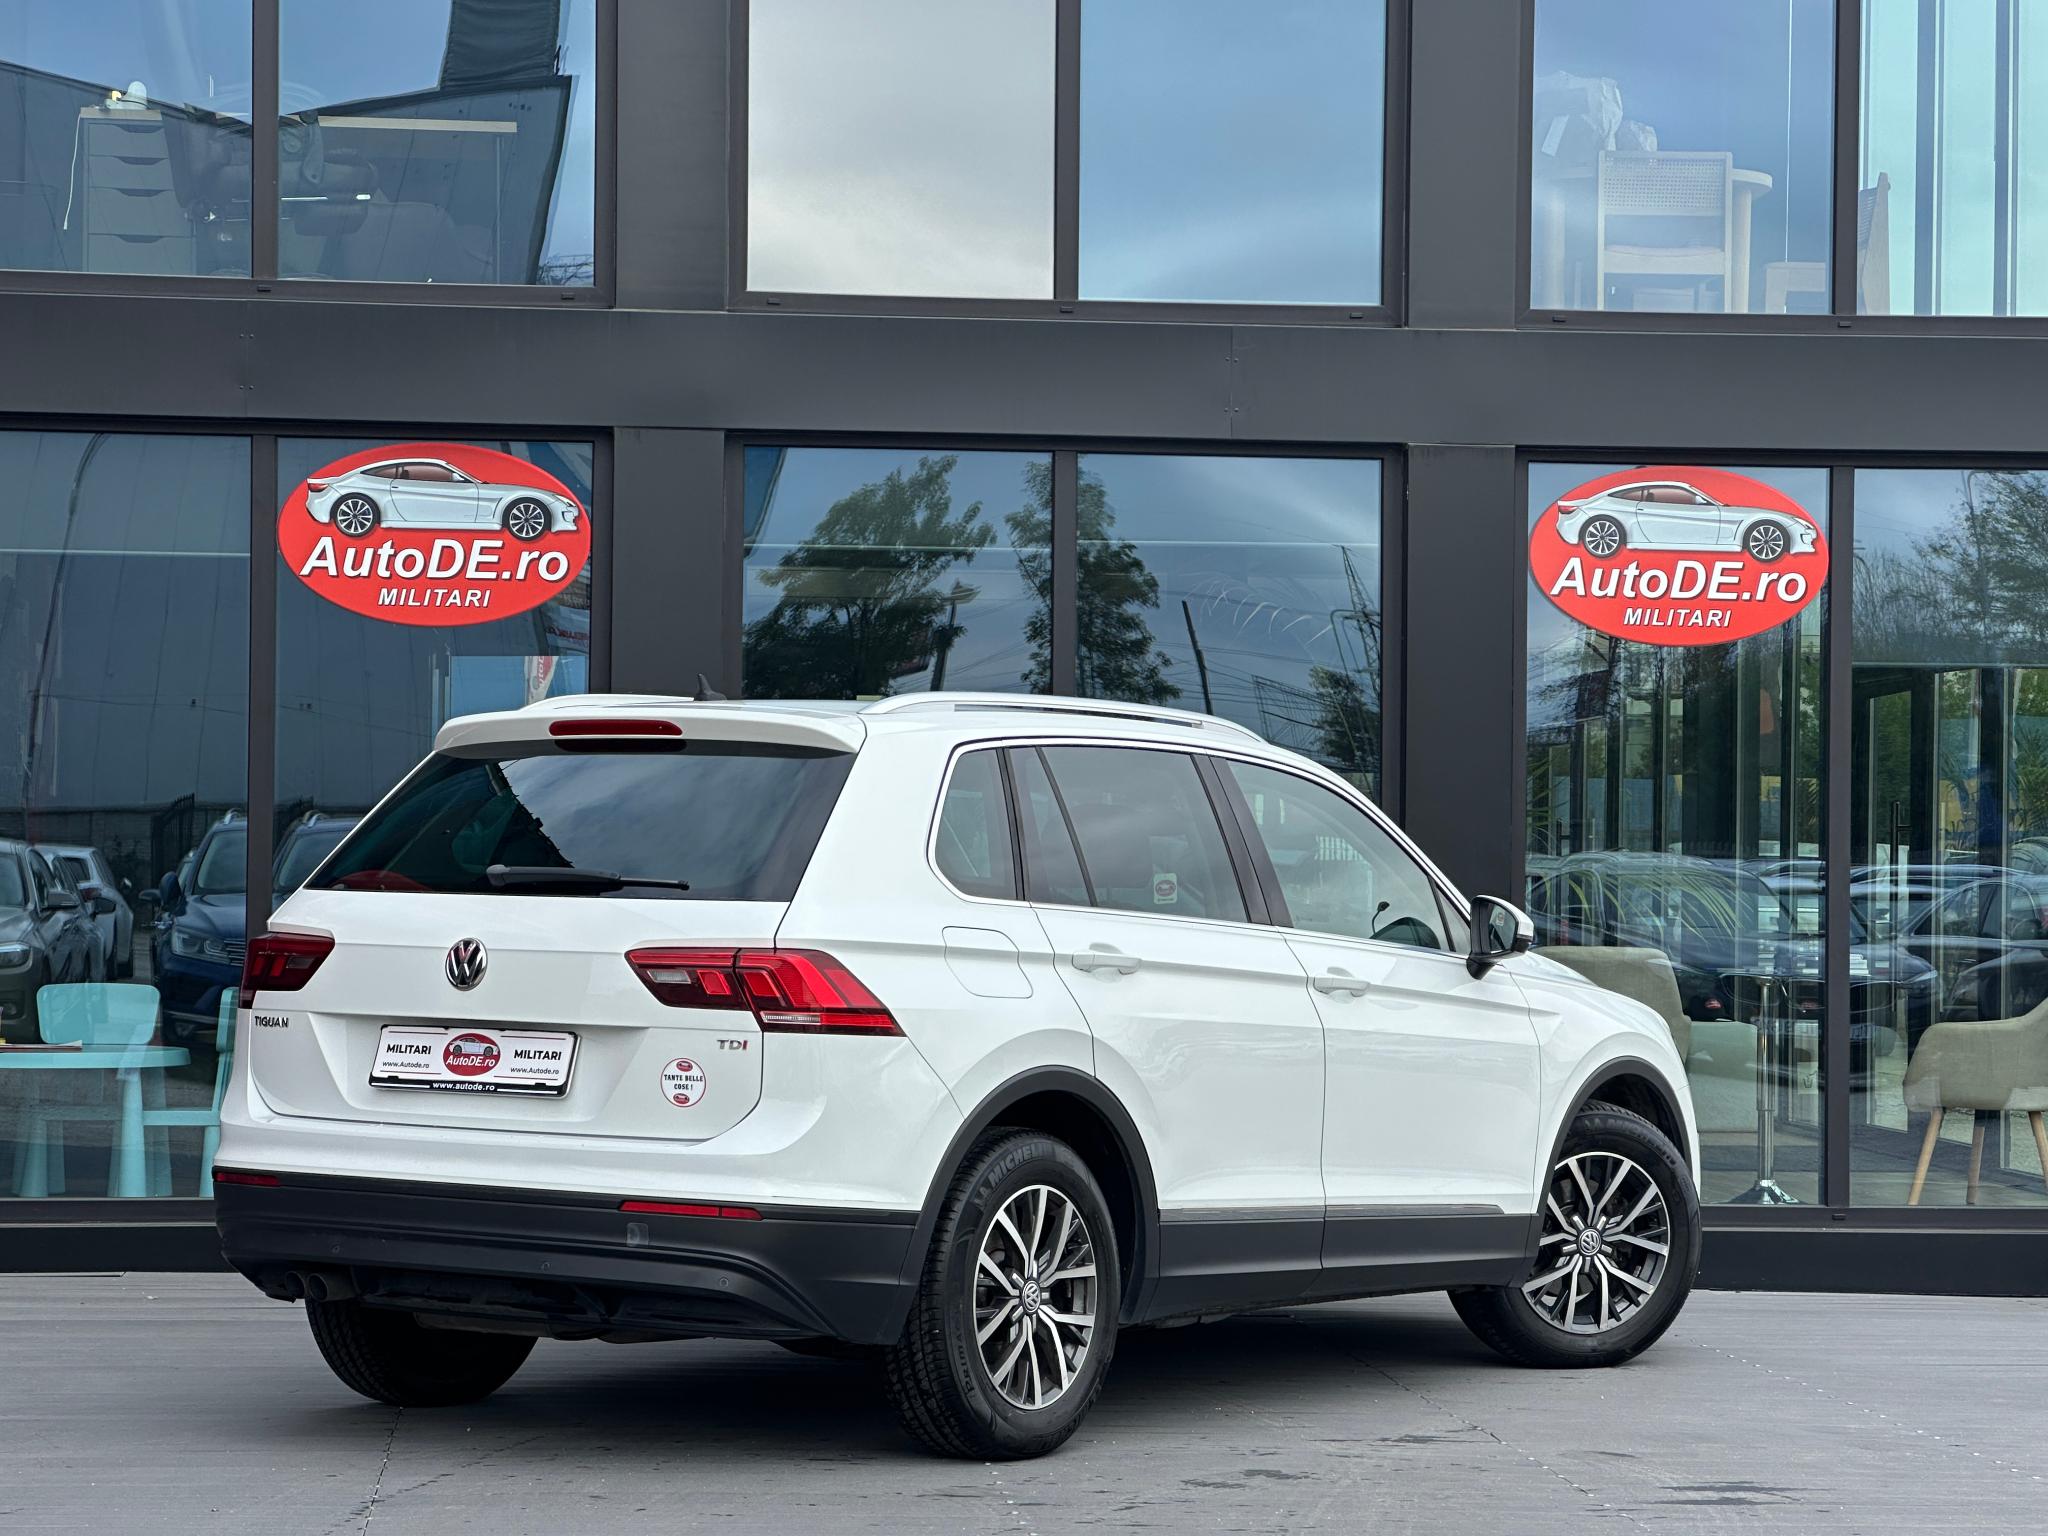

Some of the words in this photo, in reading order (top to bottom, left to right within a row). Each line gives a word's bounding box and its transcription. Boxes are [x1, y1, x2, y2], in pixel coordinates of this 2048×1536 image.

[299, 535, 570, 582] AutoDE.ro
[1550, 556, 1808, 603] AutoDE.ro
[378, 587, 491, 608] MILITARI
[1623, 607, 1732, 627] MILITARI
[254, 1015, 289, 1028] TIGUAN
[386, 1043, 432, 1055] MILITARI
[716, 1039, 748, 1051] TDI
[514, 1049, 562, 1061] MILITARI
[382, 1060, 430, 1069] www.Autode.ro
[445, 1055, 496, 1068] AutoDE.ro
[510, 1066, 560, 1075] www.Autode.ro
[432, 1081, 495, 1091] www.autode.ro
